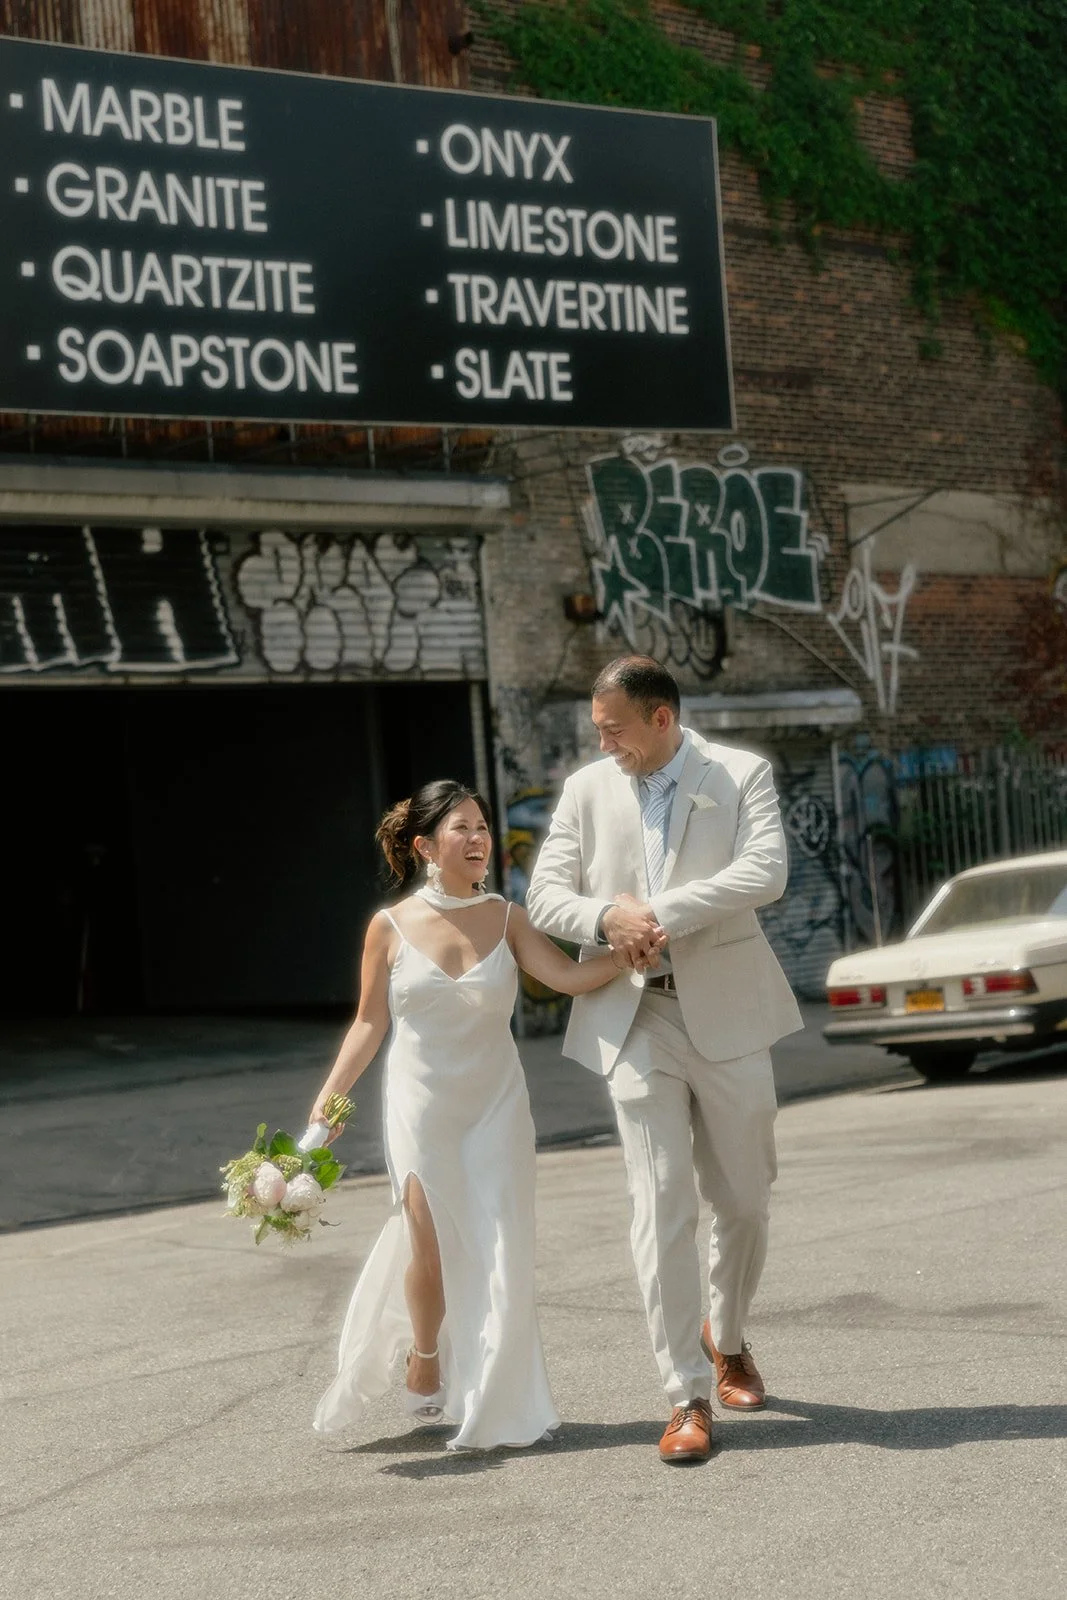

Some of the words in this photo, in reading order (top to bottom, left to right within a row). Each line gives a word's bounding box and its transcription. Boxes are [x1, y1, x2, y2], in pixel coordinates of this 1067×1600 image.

[41, 78, 245, 151] MARBLE
[440, 124, 573, 183] ONYX
[46, 162, 268, 232] GRANITE
[445, 198, 678, 263] LIMESTONE
[52, 245, 315, 314] QUARTZITE
[448, 274, 689, 334] TRAVERTINE
[58, 327, 359, 393] SOAPSTONE
[456, 348, 573, 401] SLATE
